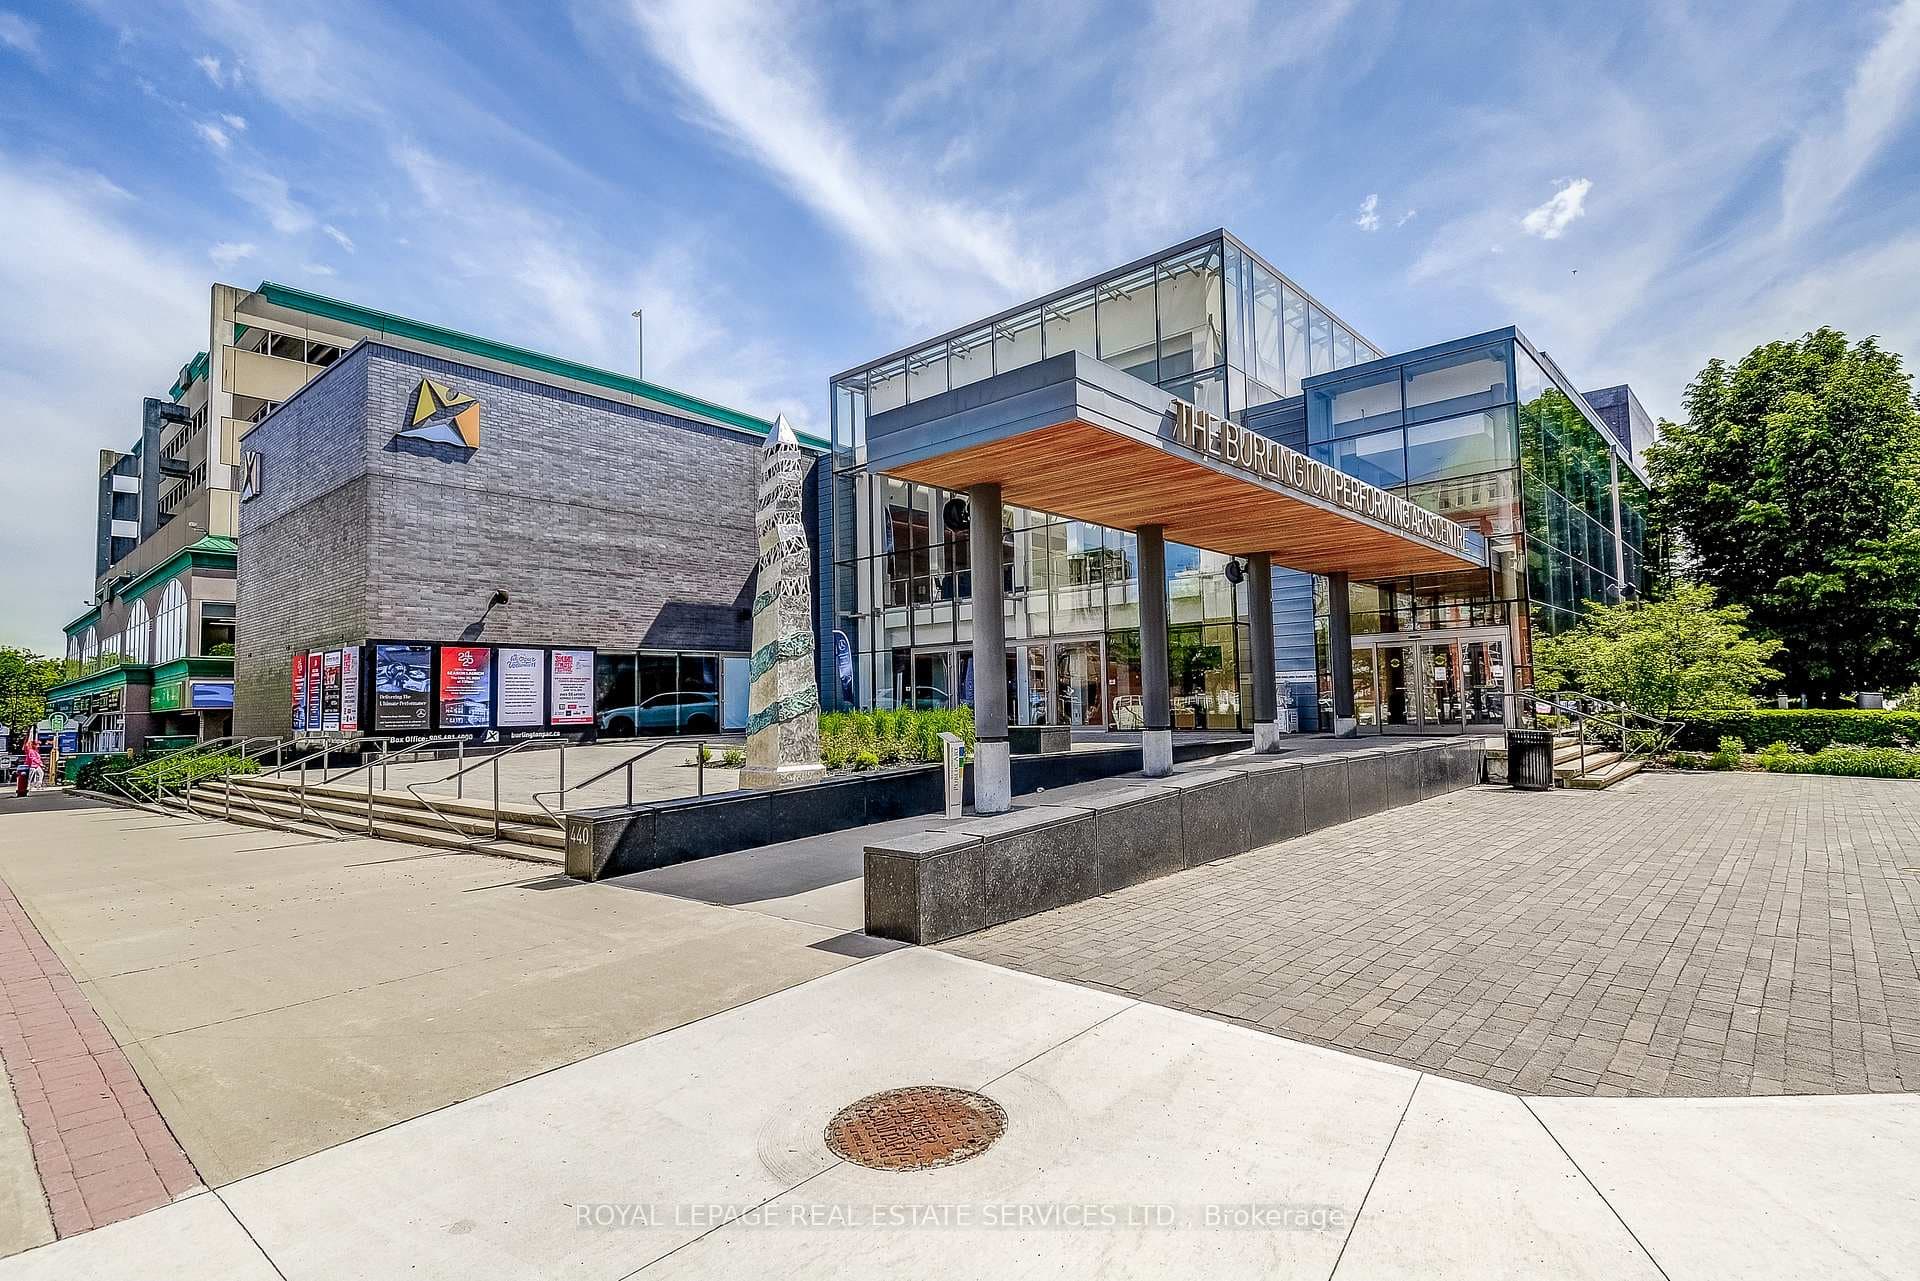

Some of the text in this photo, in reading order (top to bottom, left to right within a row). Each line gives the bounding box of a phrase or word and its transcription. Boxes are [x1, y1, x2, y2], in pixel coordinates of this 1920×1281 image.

[1172, 398, 1470, 551] THE BURLINGTON PERFORMING ARTS CENTRE
[389, 736, 404, 744] Box
[570, 825, 589, 845] 440
